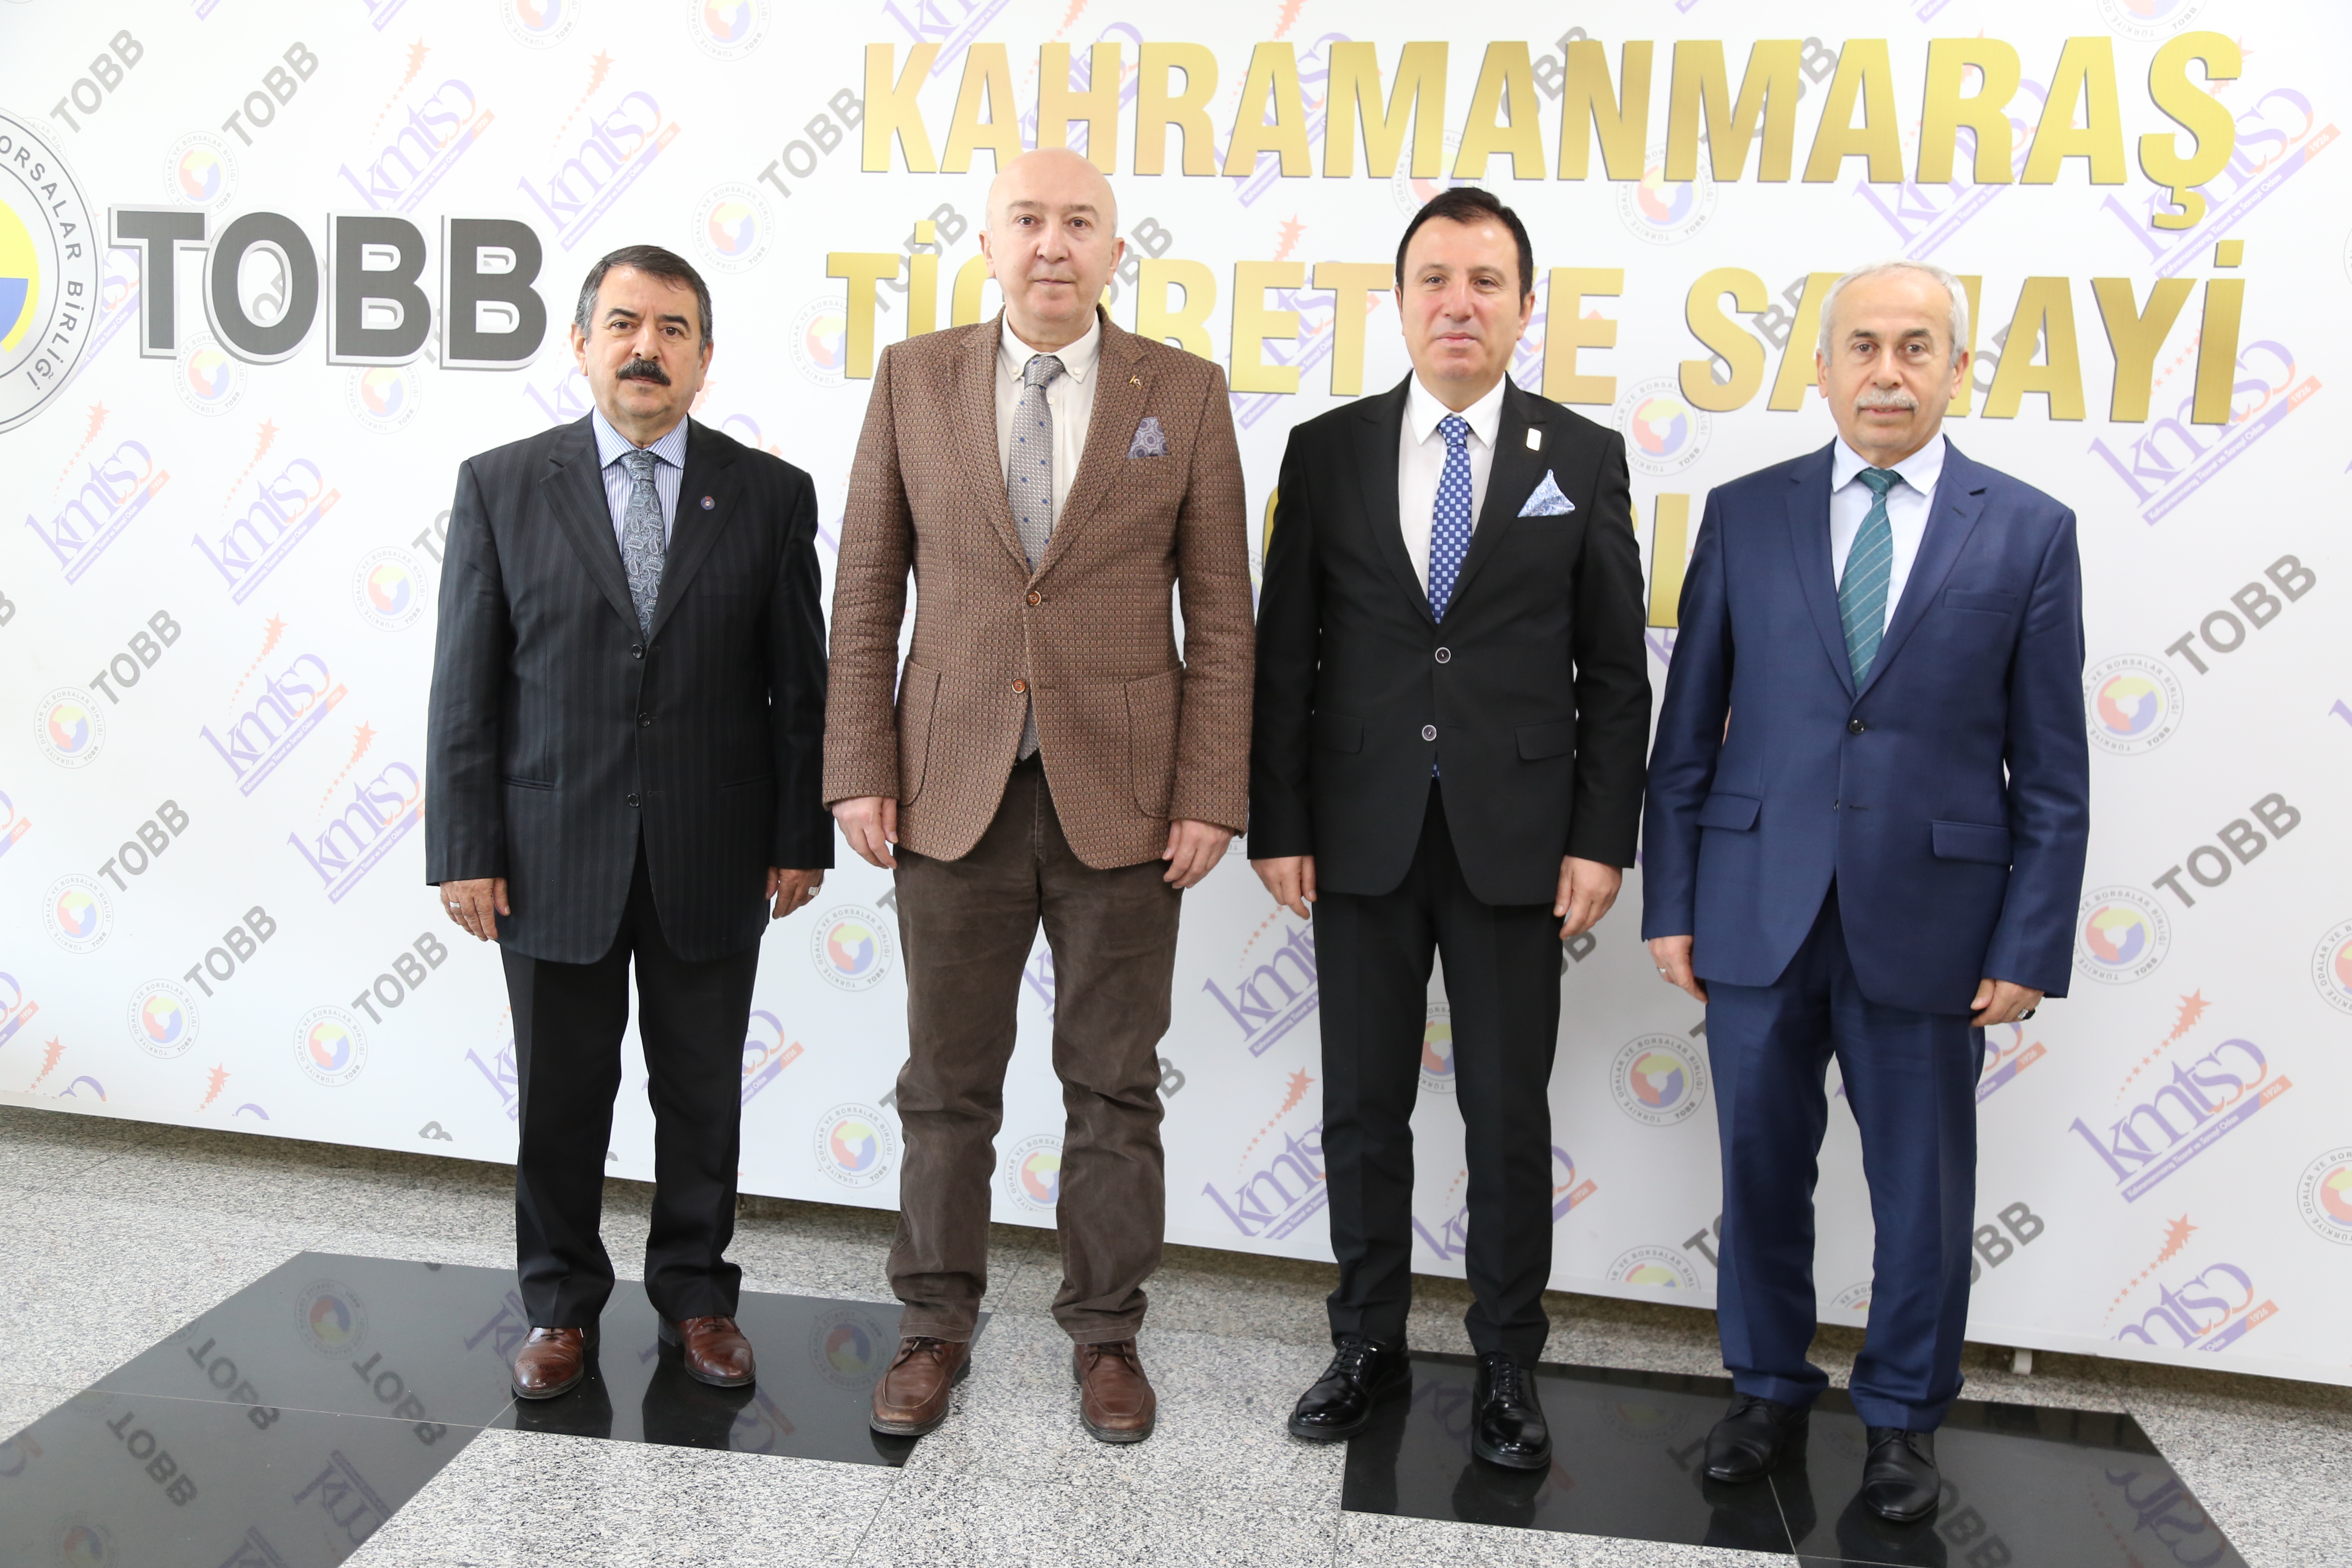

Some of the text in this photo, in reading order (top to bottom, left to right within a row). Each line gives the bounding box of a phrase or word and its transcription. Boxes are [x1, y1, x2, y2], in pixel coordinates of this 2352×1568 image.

[50, 30, 143, 133] TOBB
[221, 42, 318, 147] TOBB
[757, 88, 863, 199] TOBB
[861, 31, 2242, 230] KAHRAMANMARAŞ
[2307, 132, 2330, 152] 1926
[215, 191, 232, 211] TOBB
[702, 198, 712, 209] VE
[1685, 215, 1708, 238] TOBB
[0, 135, 85, 392] ORSALAR BİRLİĞİ
[748, 245, 766, 266] TOBB
[111, 205, 550, 368] TOBB
[827, 220, 1395, 396] TİRET
[2290, 384, 2312, 402] 1926
[151, 476, 165, 490] 1926
[361, 560, 371, 571] VE
[404, 606, 421, 625] TOBB
[2165, 555, 2316, 675] TOBB
[89, 610, 181, 704] TOBB
[328, 690, 342, 704] 1926
[38, 710, 46, 745] ODALAR
[43, 700, 51, 710] VE
[52, 691, 90, 704] BORSALAR
[83, 745, 99, 763] TOBB
[12, 823, 27, 838] 1926
[98, 800, 189, 891] TOBB
[2152, 793, 2301, 908] TOBB
[46, 896, 55, 930] ODALAR
[51, 886, 59, 896] VE
[60, 878, 98, 891] BORSALAR
[91, 931, 107, 948] TOBB
[183, 906, 276, 997] TOBB
[815, 929, 824, 965] ODALAR
[821, 918, 831, 928] VE
[832, 909, 876, 923] BORSALAR
[2328, 931, 2342, 944] VE
[351, 932, 447, 1024] TOBB
[867, 967, 885, 985] TOBB
[21, 1007, 34, 1020] 1926
[131, 1001, 140, 1035] ODALAR
[136, 991, 145, 1001] VE
[146, 983, 184, 996] BORSALAR
[177, 1036, 193, 1053] TOBB
[297, 1028, 306, 1062] ODALAR
[303, 1017, 312, 1027] VE
[312, 1009, 352, 1023] BORSALAR
[344, 1064, 361, 1081] TOBB
[782, 1048, 797, 1063] 1926
[818, 1126, 827, 1162] ODALAR
[824, 1115, 834, 1126] VE
[835, 1107, 879, 1122] BORSALAR
[869, 1164, 888, 1182] TOBB
[2303, 1161, 2327, 1215] ODALAR VE
